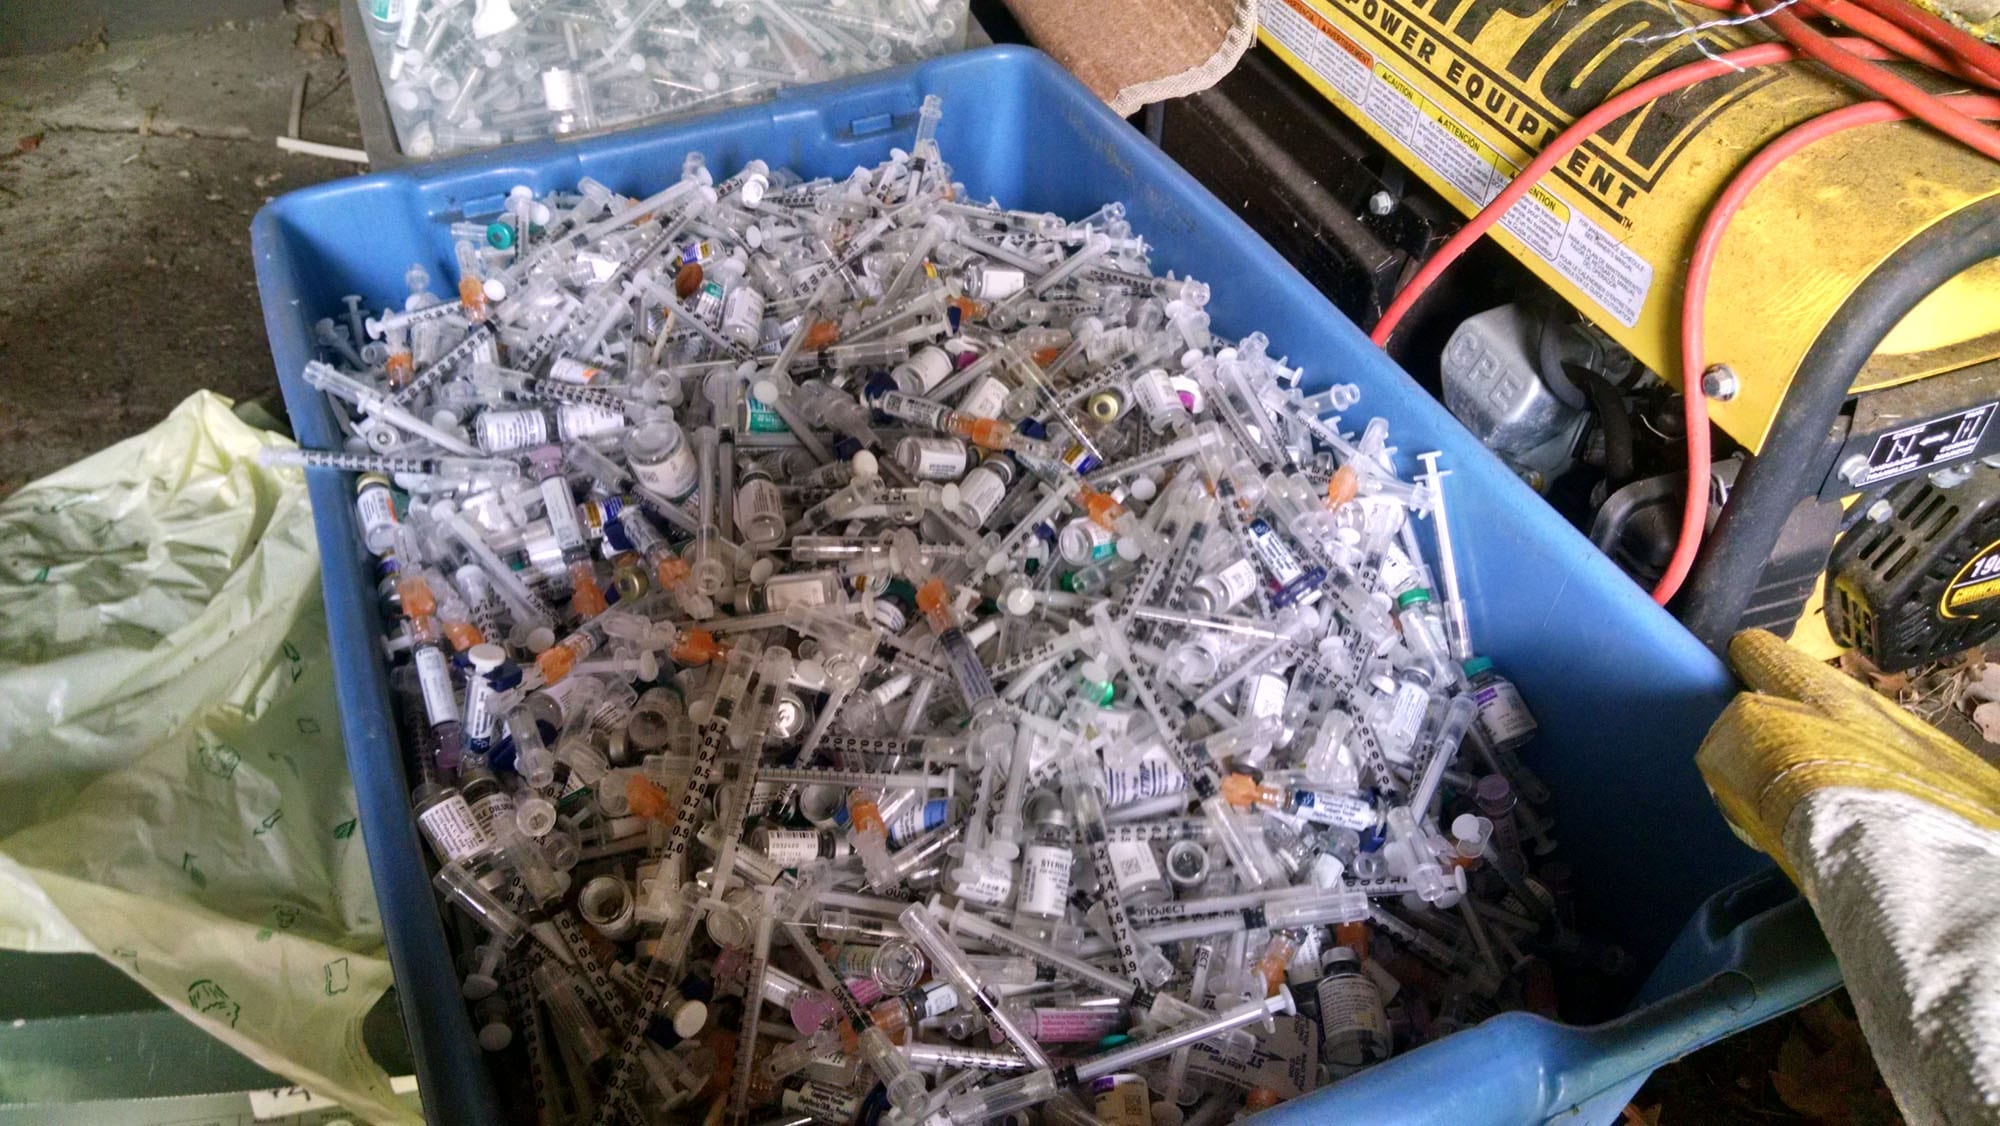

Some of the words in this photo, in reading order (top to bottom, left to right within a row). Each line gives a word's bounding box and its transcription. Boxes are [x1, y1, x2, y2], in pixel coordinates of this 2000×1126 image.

[1384, 74, 1415, 100] CAUTION
[1442, 118, 1482, 151] ATTENCIÓN
[694, 765, 712, 779] 0.5
[688, 780, 706, 794] 0.6
[683, 795, 701, 808] 0.7
[677, 809, 696, 824] 0.8
[672, 824, 690, 838] 0.9
[667, 840, 684, 854] 1.0
